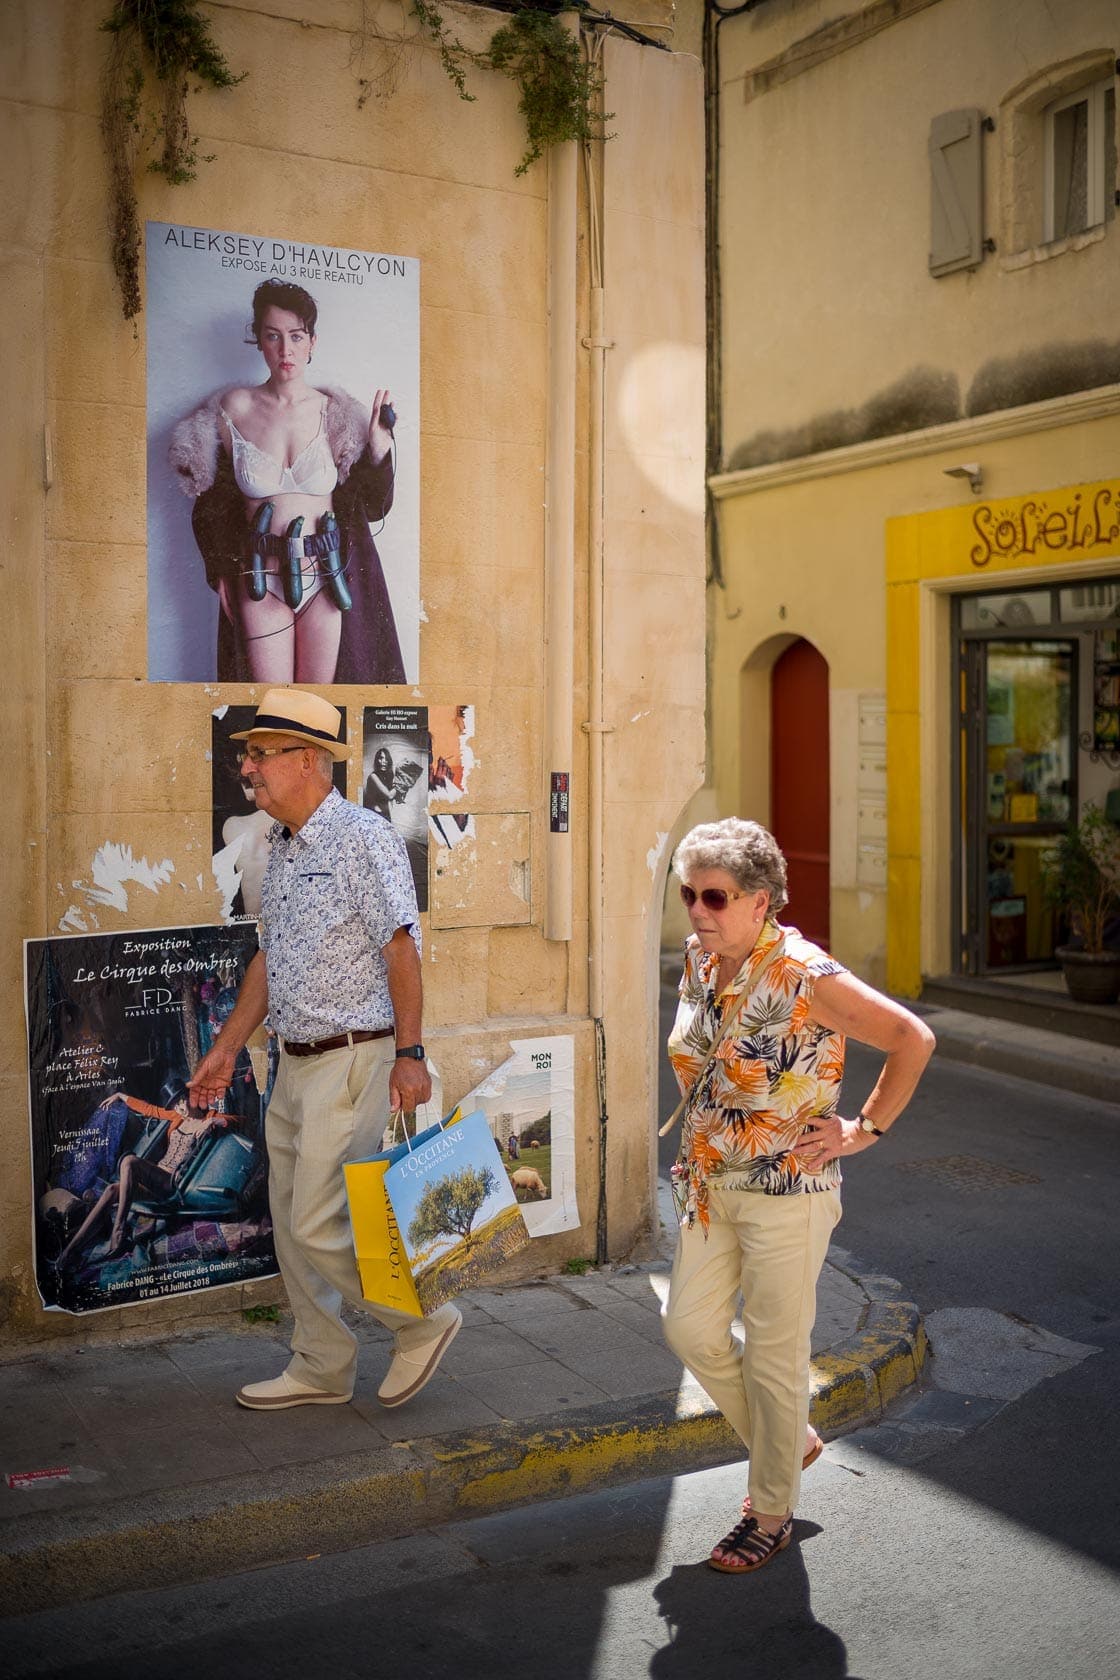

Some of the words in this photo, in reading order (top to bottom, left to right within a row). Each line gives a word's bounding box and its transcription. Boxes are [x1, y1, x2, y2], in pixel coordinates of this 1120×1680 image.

[164, 228, 265, 258] ALEKSEY
[271, 243, 406, 277] D'HAVLCYON
[221, 256, 268, 274] EXPOSE
[270, 262, 288, 276] AU
[289, 265, 297, 277] 3
[300, 266, 322, 280] RUE
[324, 270, 364, 286] REATTU
[375, 722, 387, 730] Cris
[387, 722, 400, 730] dans
[400, 722, 406, 730] la
[123, 937, 192, 959] Exposition
[73, 968, 96, 983] Le
[100, 963, 157, 984] Cirque
[160, 959, 183, 979] des
[186, 953, 239, 972] Ombres
[142, 988, 172, 1008] FD
[125, 1008, 160, 1018] FABRICE
[165, 1005, 188, 1014] DANG
[59, 1045, 95, 1057] Atelier
[531, 1052, 552, 1062] MON
[46, 1062, 72, 1078] place
[74, 1057, 98, 1069] Félix
[100, 1056, 119, 1070] Rey
[75, 1070, 101, 1080] Arles
[536, 1060, 552, 1070] ROI
[59, 1127, 101, 1139] Vernissage
[51, 1141, 75, 1158] Jeudi
[82, 1136, 110, 1151] juillet
[400, 1128, 465, 1179] L'OCCITANE
[107, 1279, 134, 1291] Fabrice
[135, 1275, 154, 1288] DANG
[172, 1269, 196, 1281] Cirque
[197, 1266, 209, 1275] des
[139, 1289, 149, 1298] 01
[150, 1287, 159, 1296] au
[160, 1285, 169, 1294] 14
[170, 1281, 192, 1293] Juillet
[192, 1276, 210, 1288] 2018
